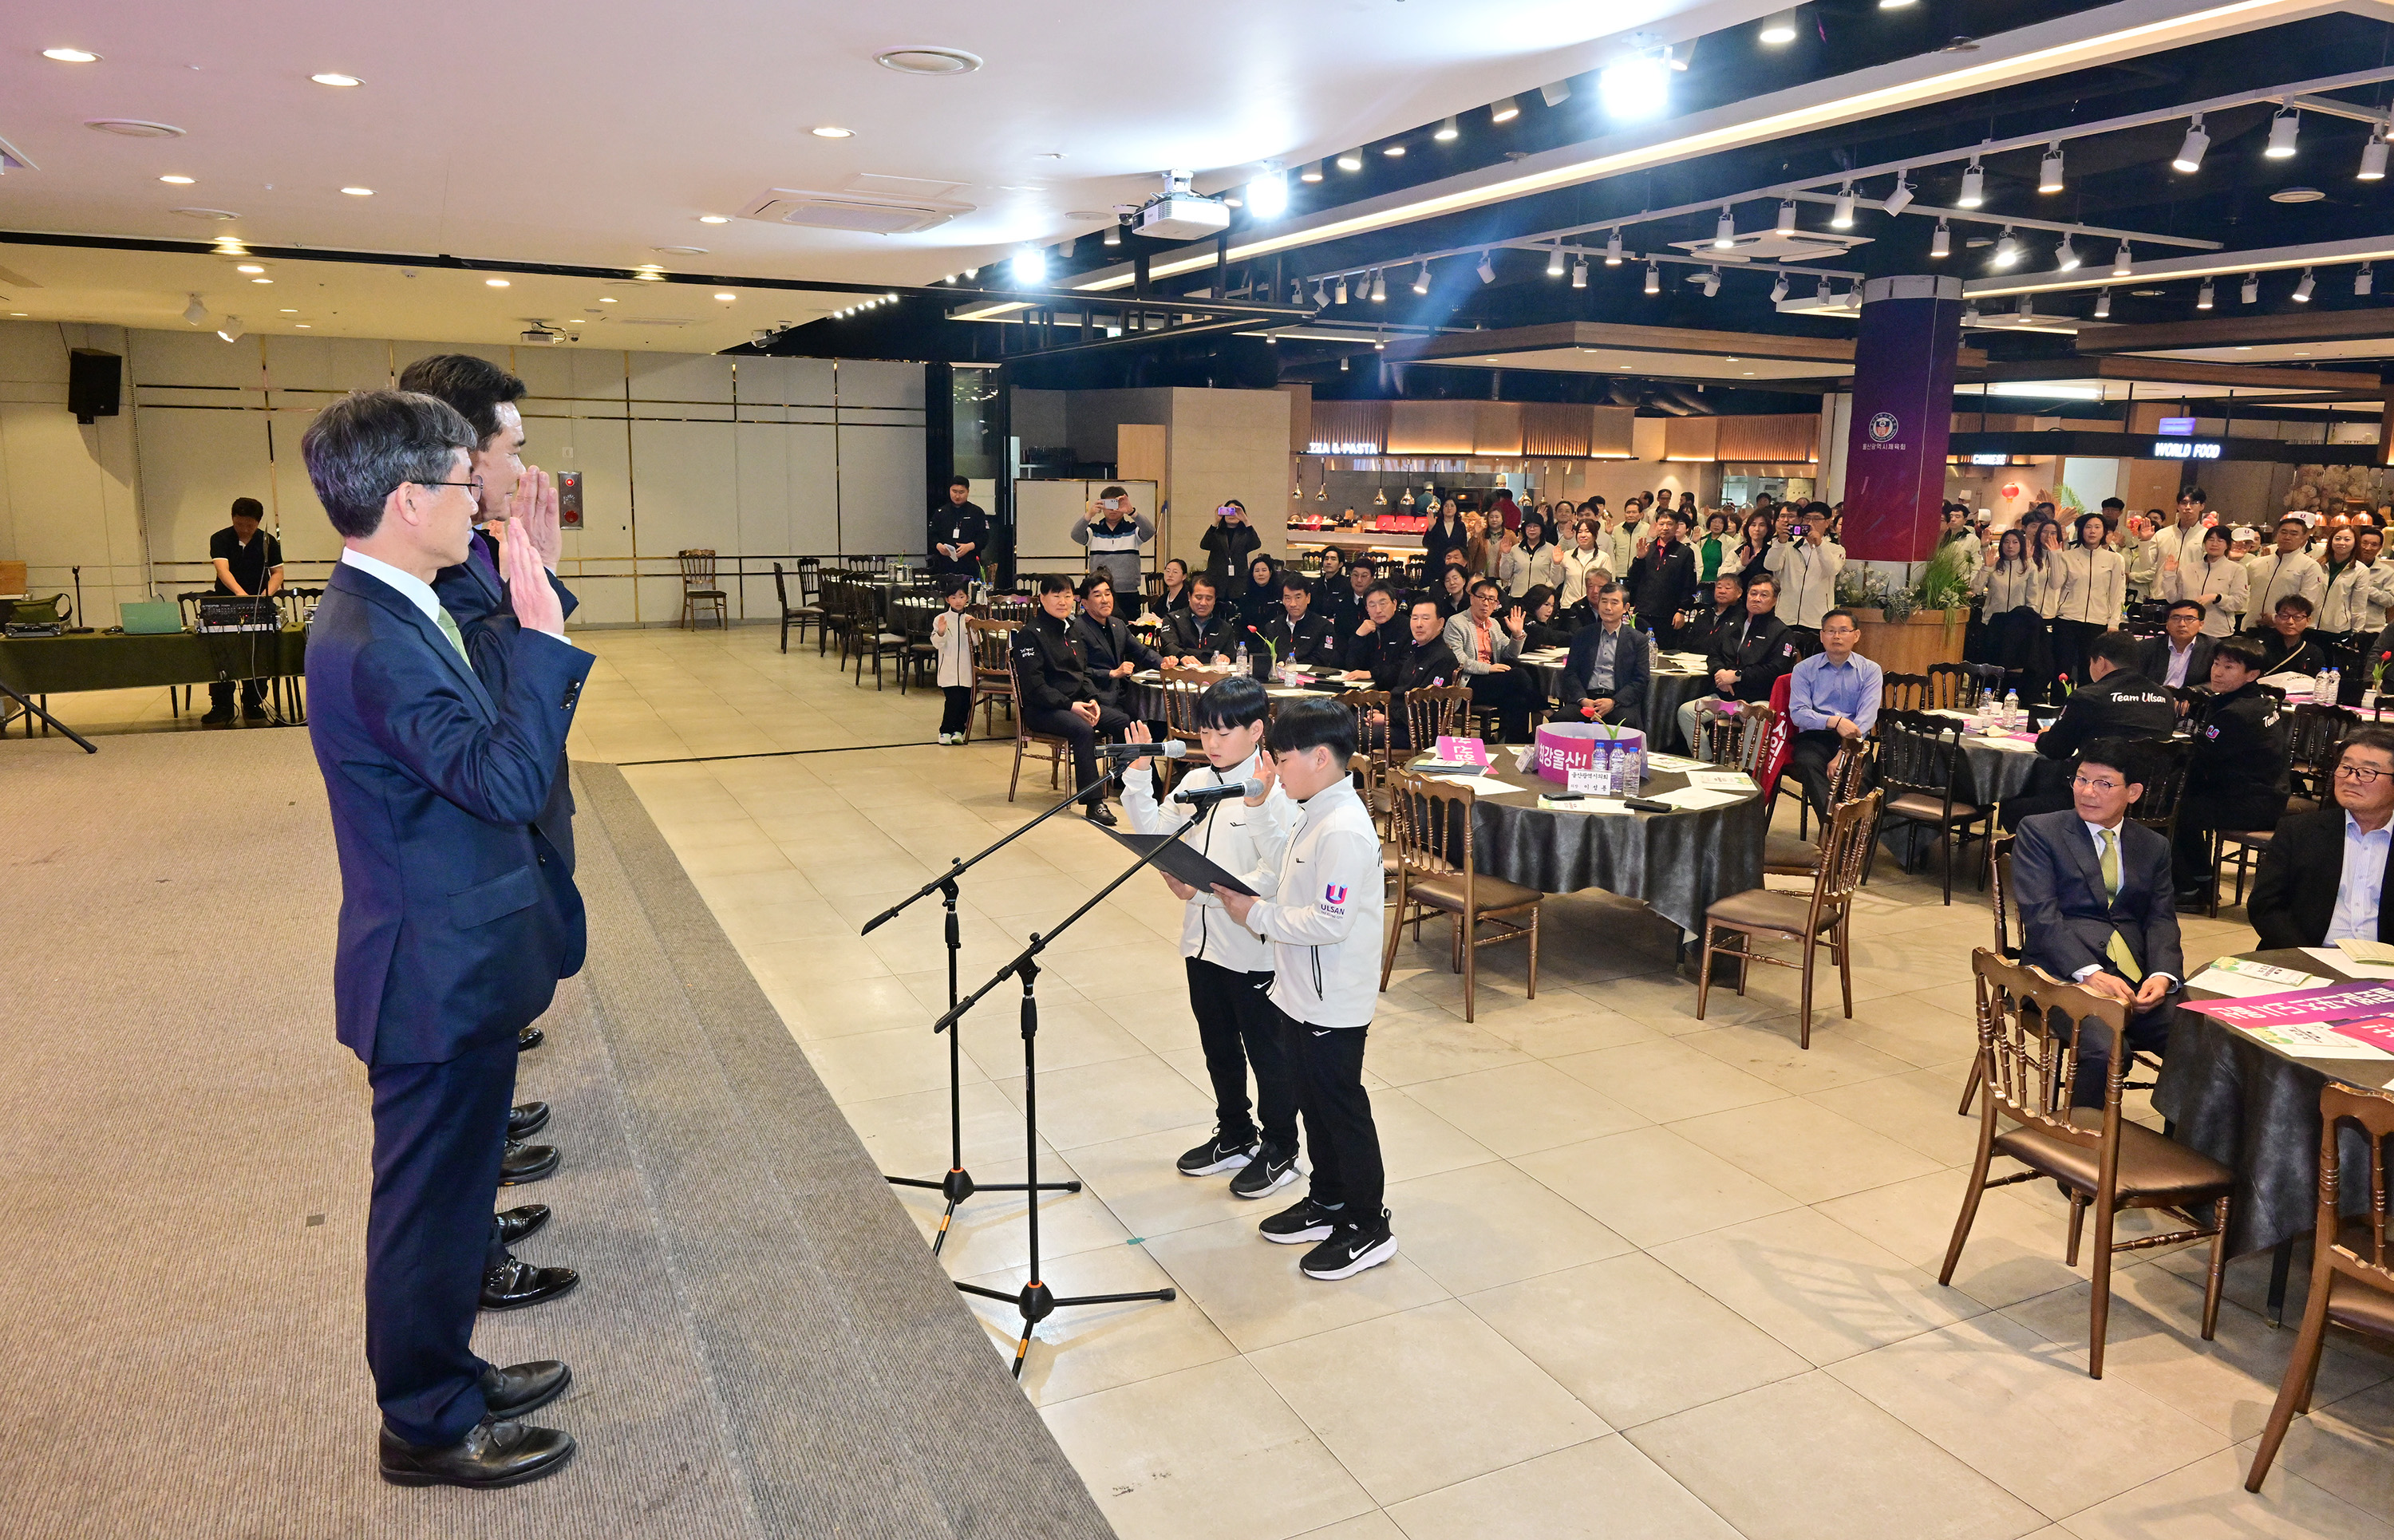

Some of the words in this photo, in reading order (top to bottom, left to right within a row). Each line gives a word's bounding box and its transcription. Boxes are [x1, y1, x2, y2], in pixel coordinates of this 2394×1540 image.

[1342, 442, 1378, 454] PASTA
[2155, 442, 2191, 458] WORLD
[2192, 444, 2221, 459] FOOD
[2110, 692, 2139, 703] Team
[2141, 692, 2167, 704] Ulsan
[1539, 743, 1587, 772] 최강울산!
[1571, 772, 1609, 780] 울산광역시의회
[1321, 903, 1345, 915] ULSAN
[2208, 1006, 2267, 1020] 울산
